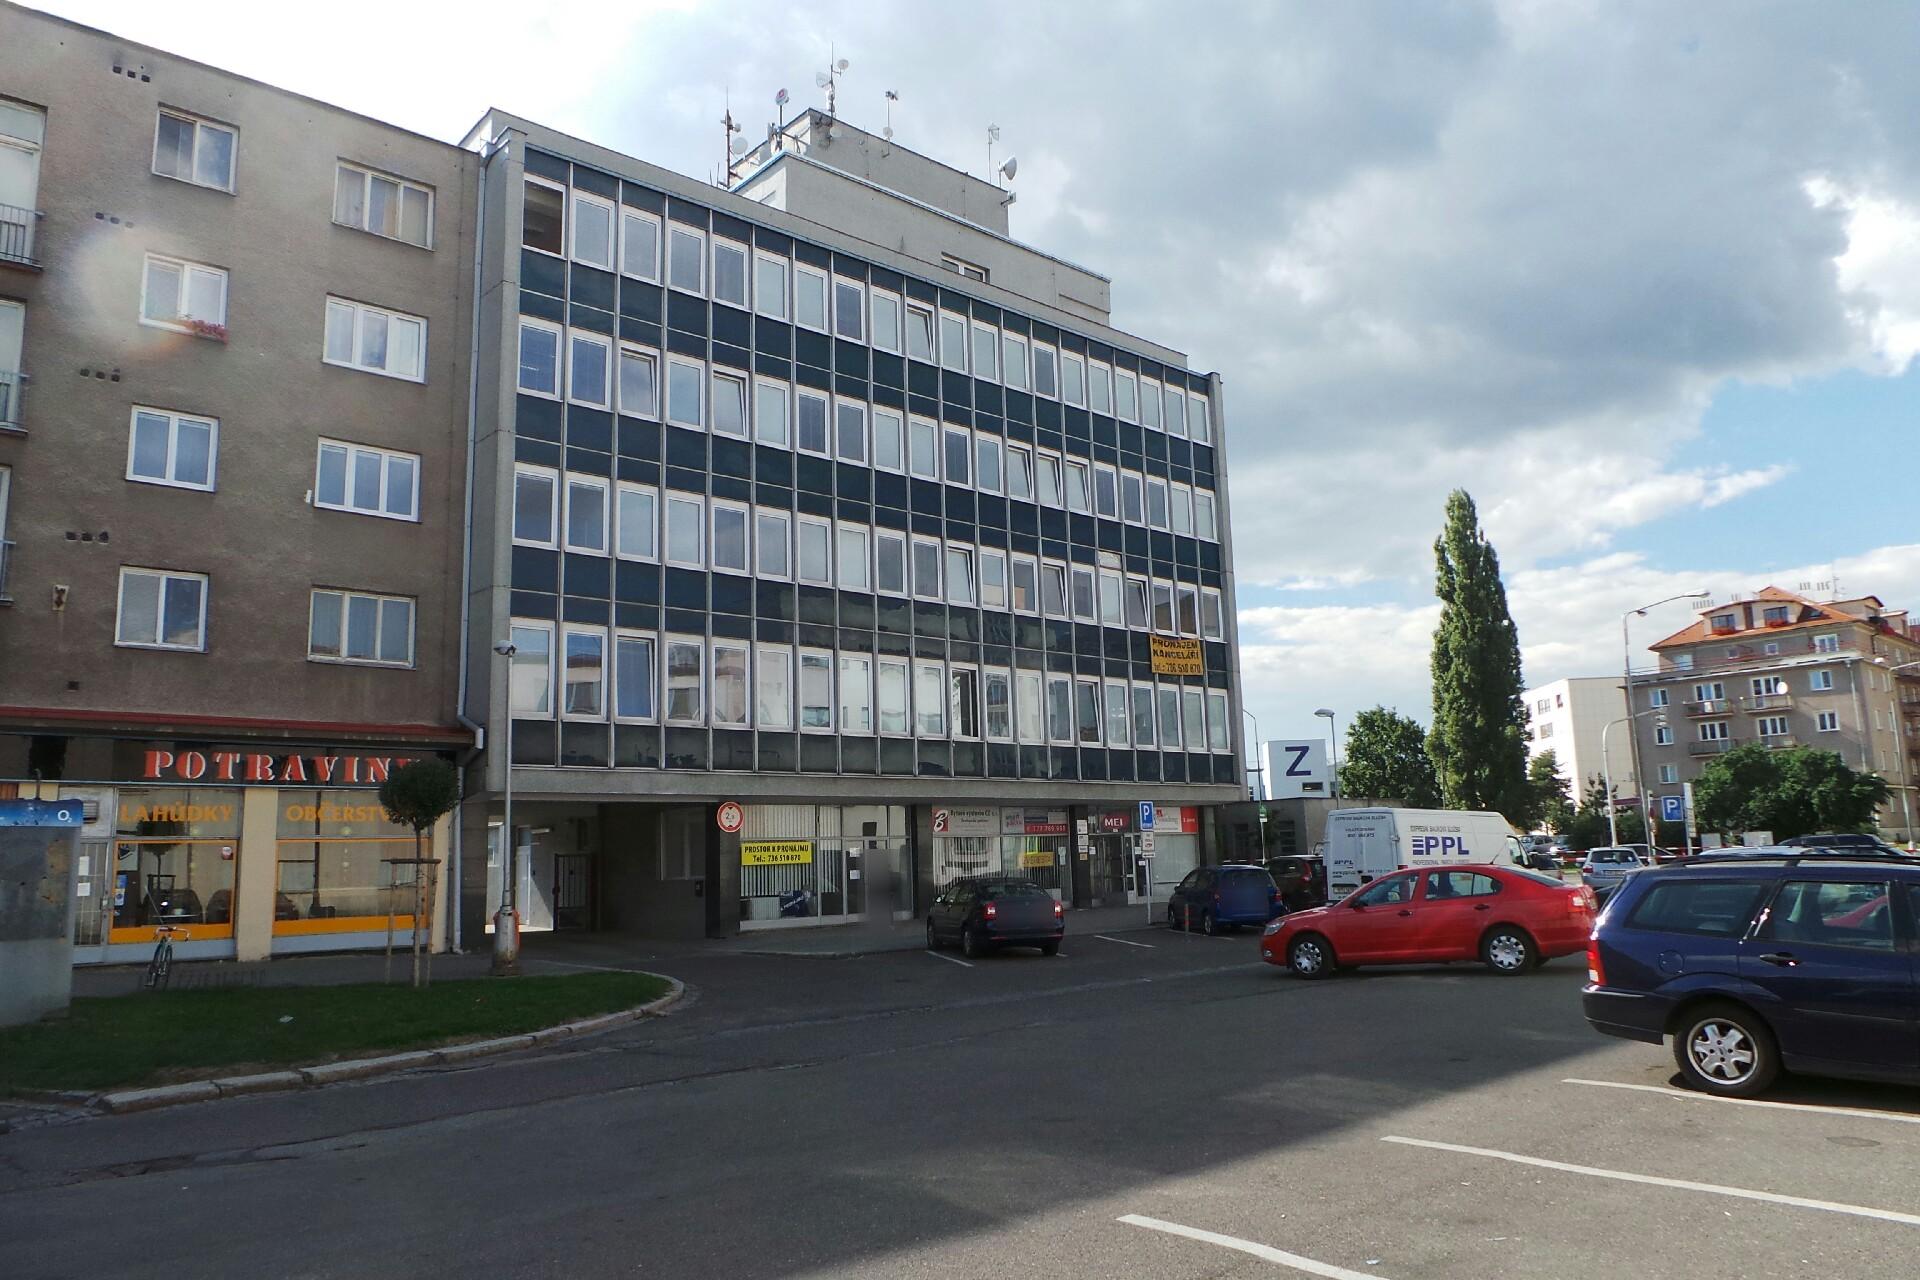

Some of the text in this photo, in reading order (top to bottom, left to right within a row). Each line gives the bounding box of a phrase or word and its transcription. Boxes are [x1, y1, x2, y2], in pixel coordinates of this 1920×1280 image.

[143, 750, 420, 783] POTRAVIN
[1285, 746, 1312, 776] Z
[1143, 805, 1150, 821] P
[1666, 799, 1678, 813] P
[744, 845, 771, 853] PROSTOR
